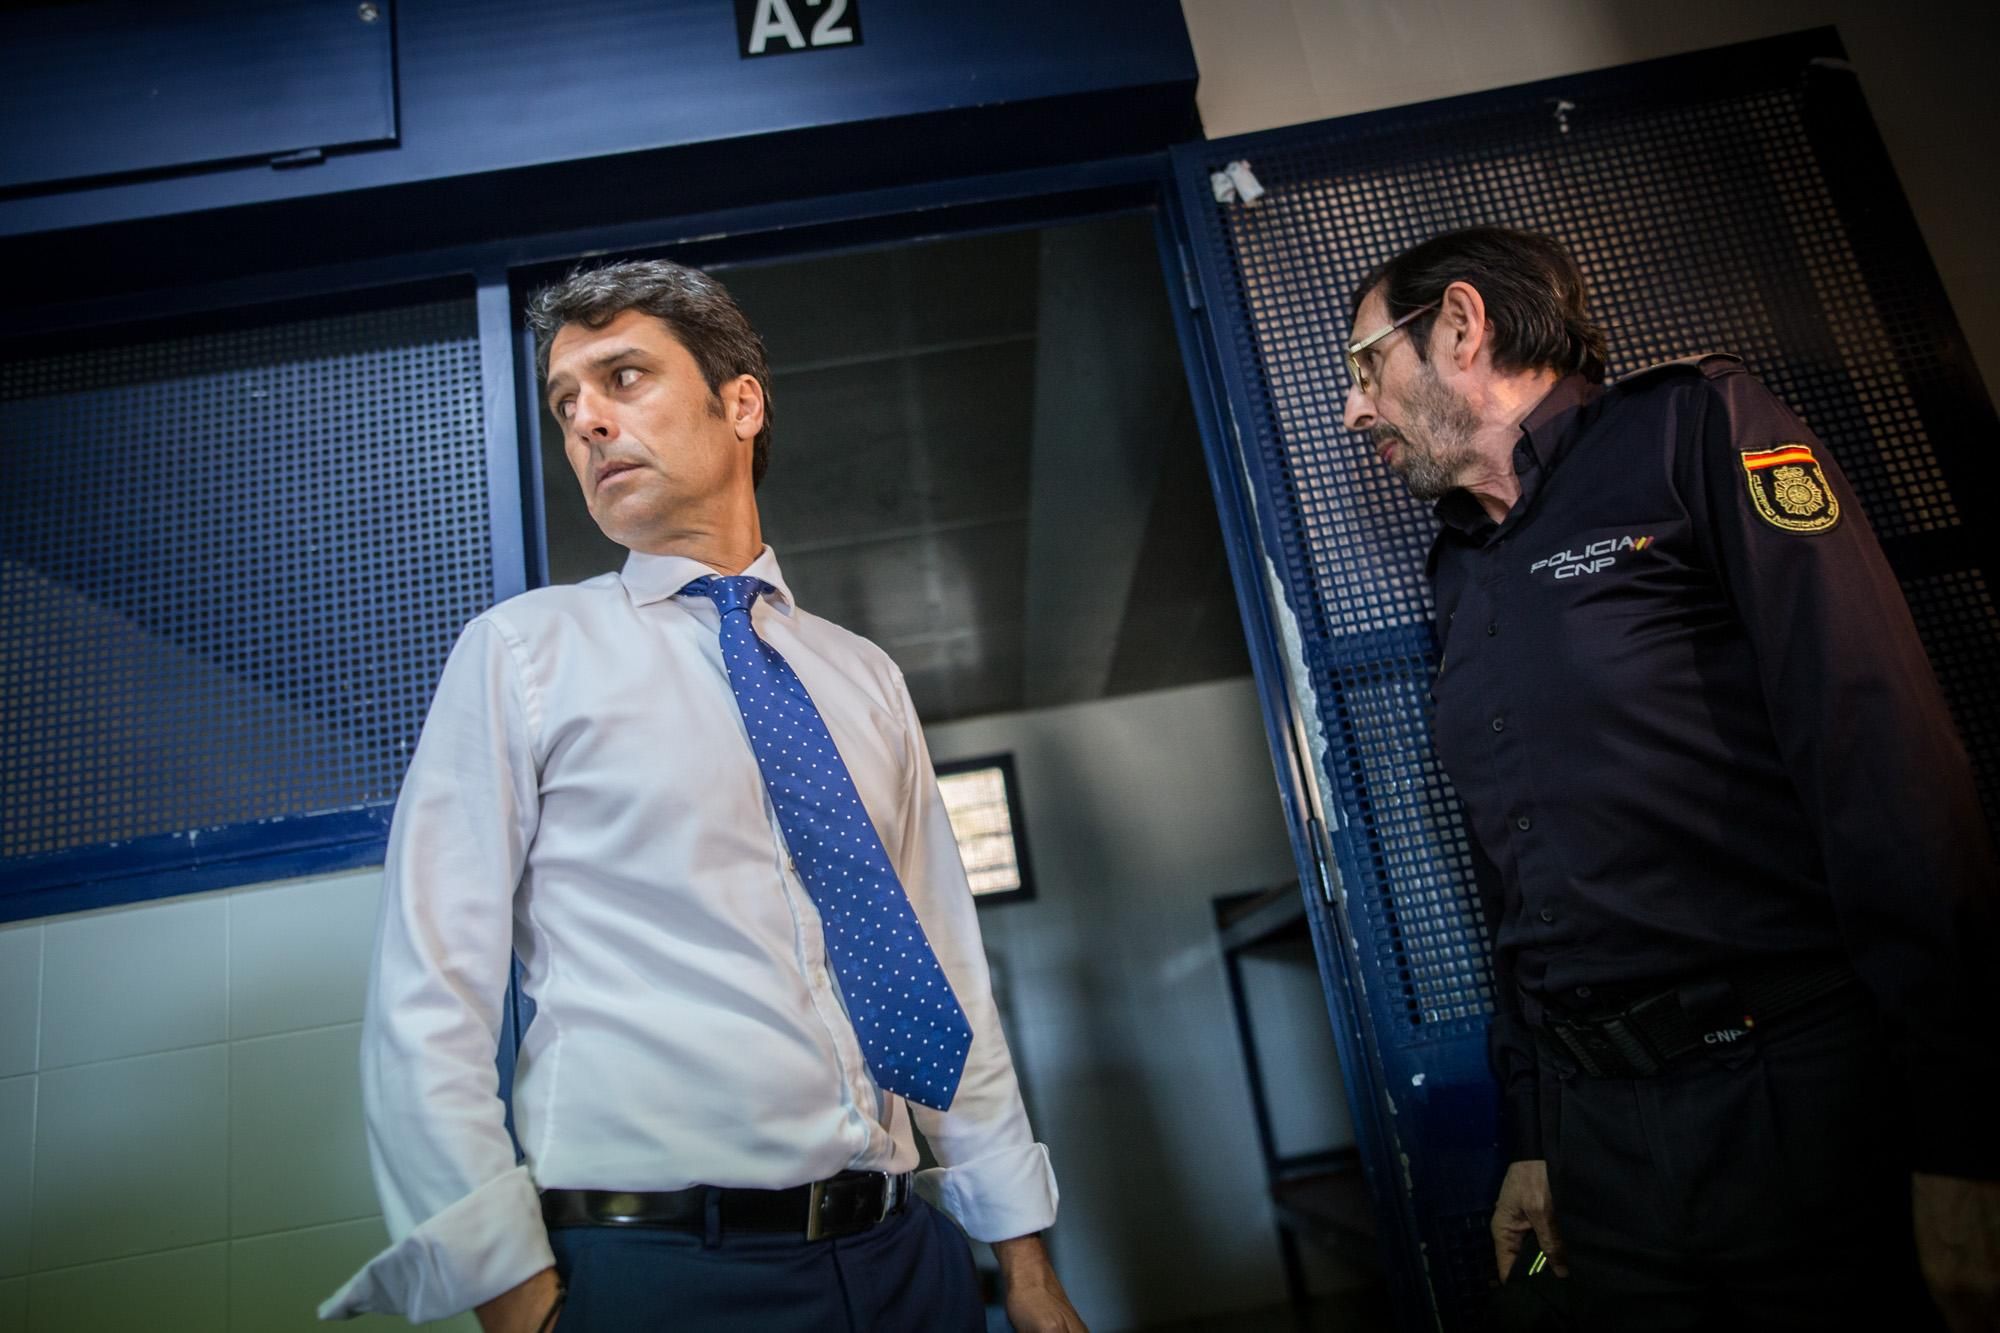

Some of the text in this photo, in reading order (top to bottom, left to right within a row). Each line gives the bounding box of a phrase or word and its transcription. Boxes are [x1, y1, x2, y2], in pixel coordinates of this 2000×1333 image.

[749, 0, 853, 53] A2
[1752, 474, 1776, 517] CUERPO
[1529, 535, 1635, 574] POLICIA
[1554, 556, 1616, 579] CNP
[1703, 1029, 1744, 1044] CNP
